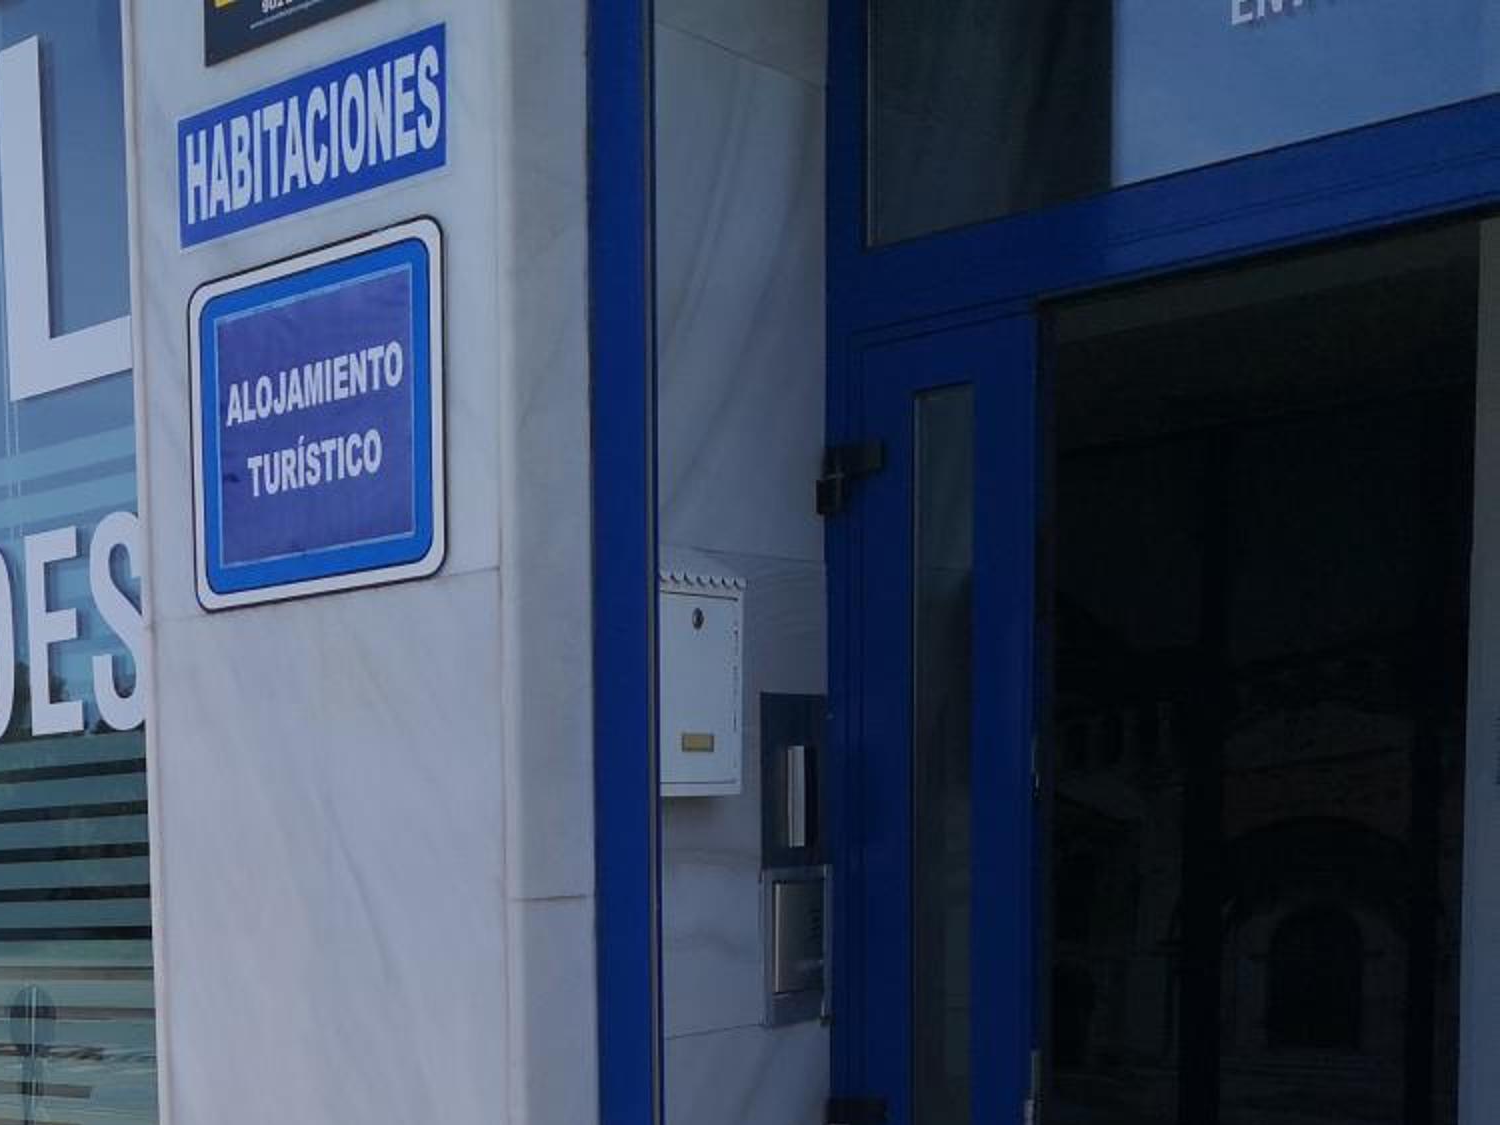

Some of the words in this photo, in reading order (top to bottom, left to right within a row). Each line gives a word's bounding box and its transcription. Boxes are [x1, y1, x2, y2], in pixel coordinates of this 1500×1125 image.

[185, 43, 440, 225] HABITACIONES
[226, 340, 403, 426] ALOJAMIENTO
[247, 428, 382, 497] TURÍSTICO
